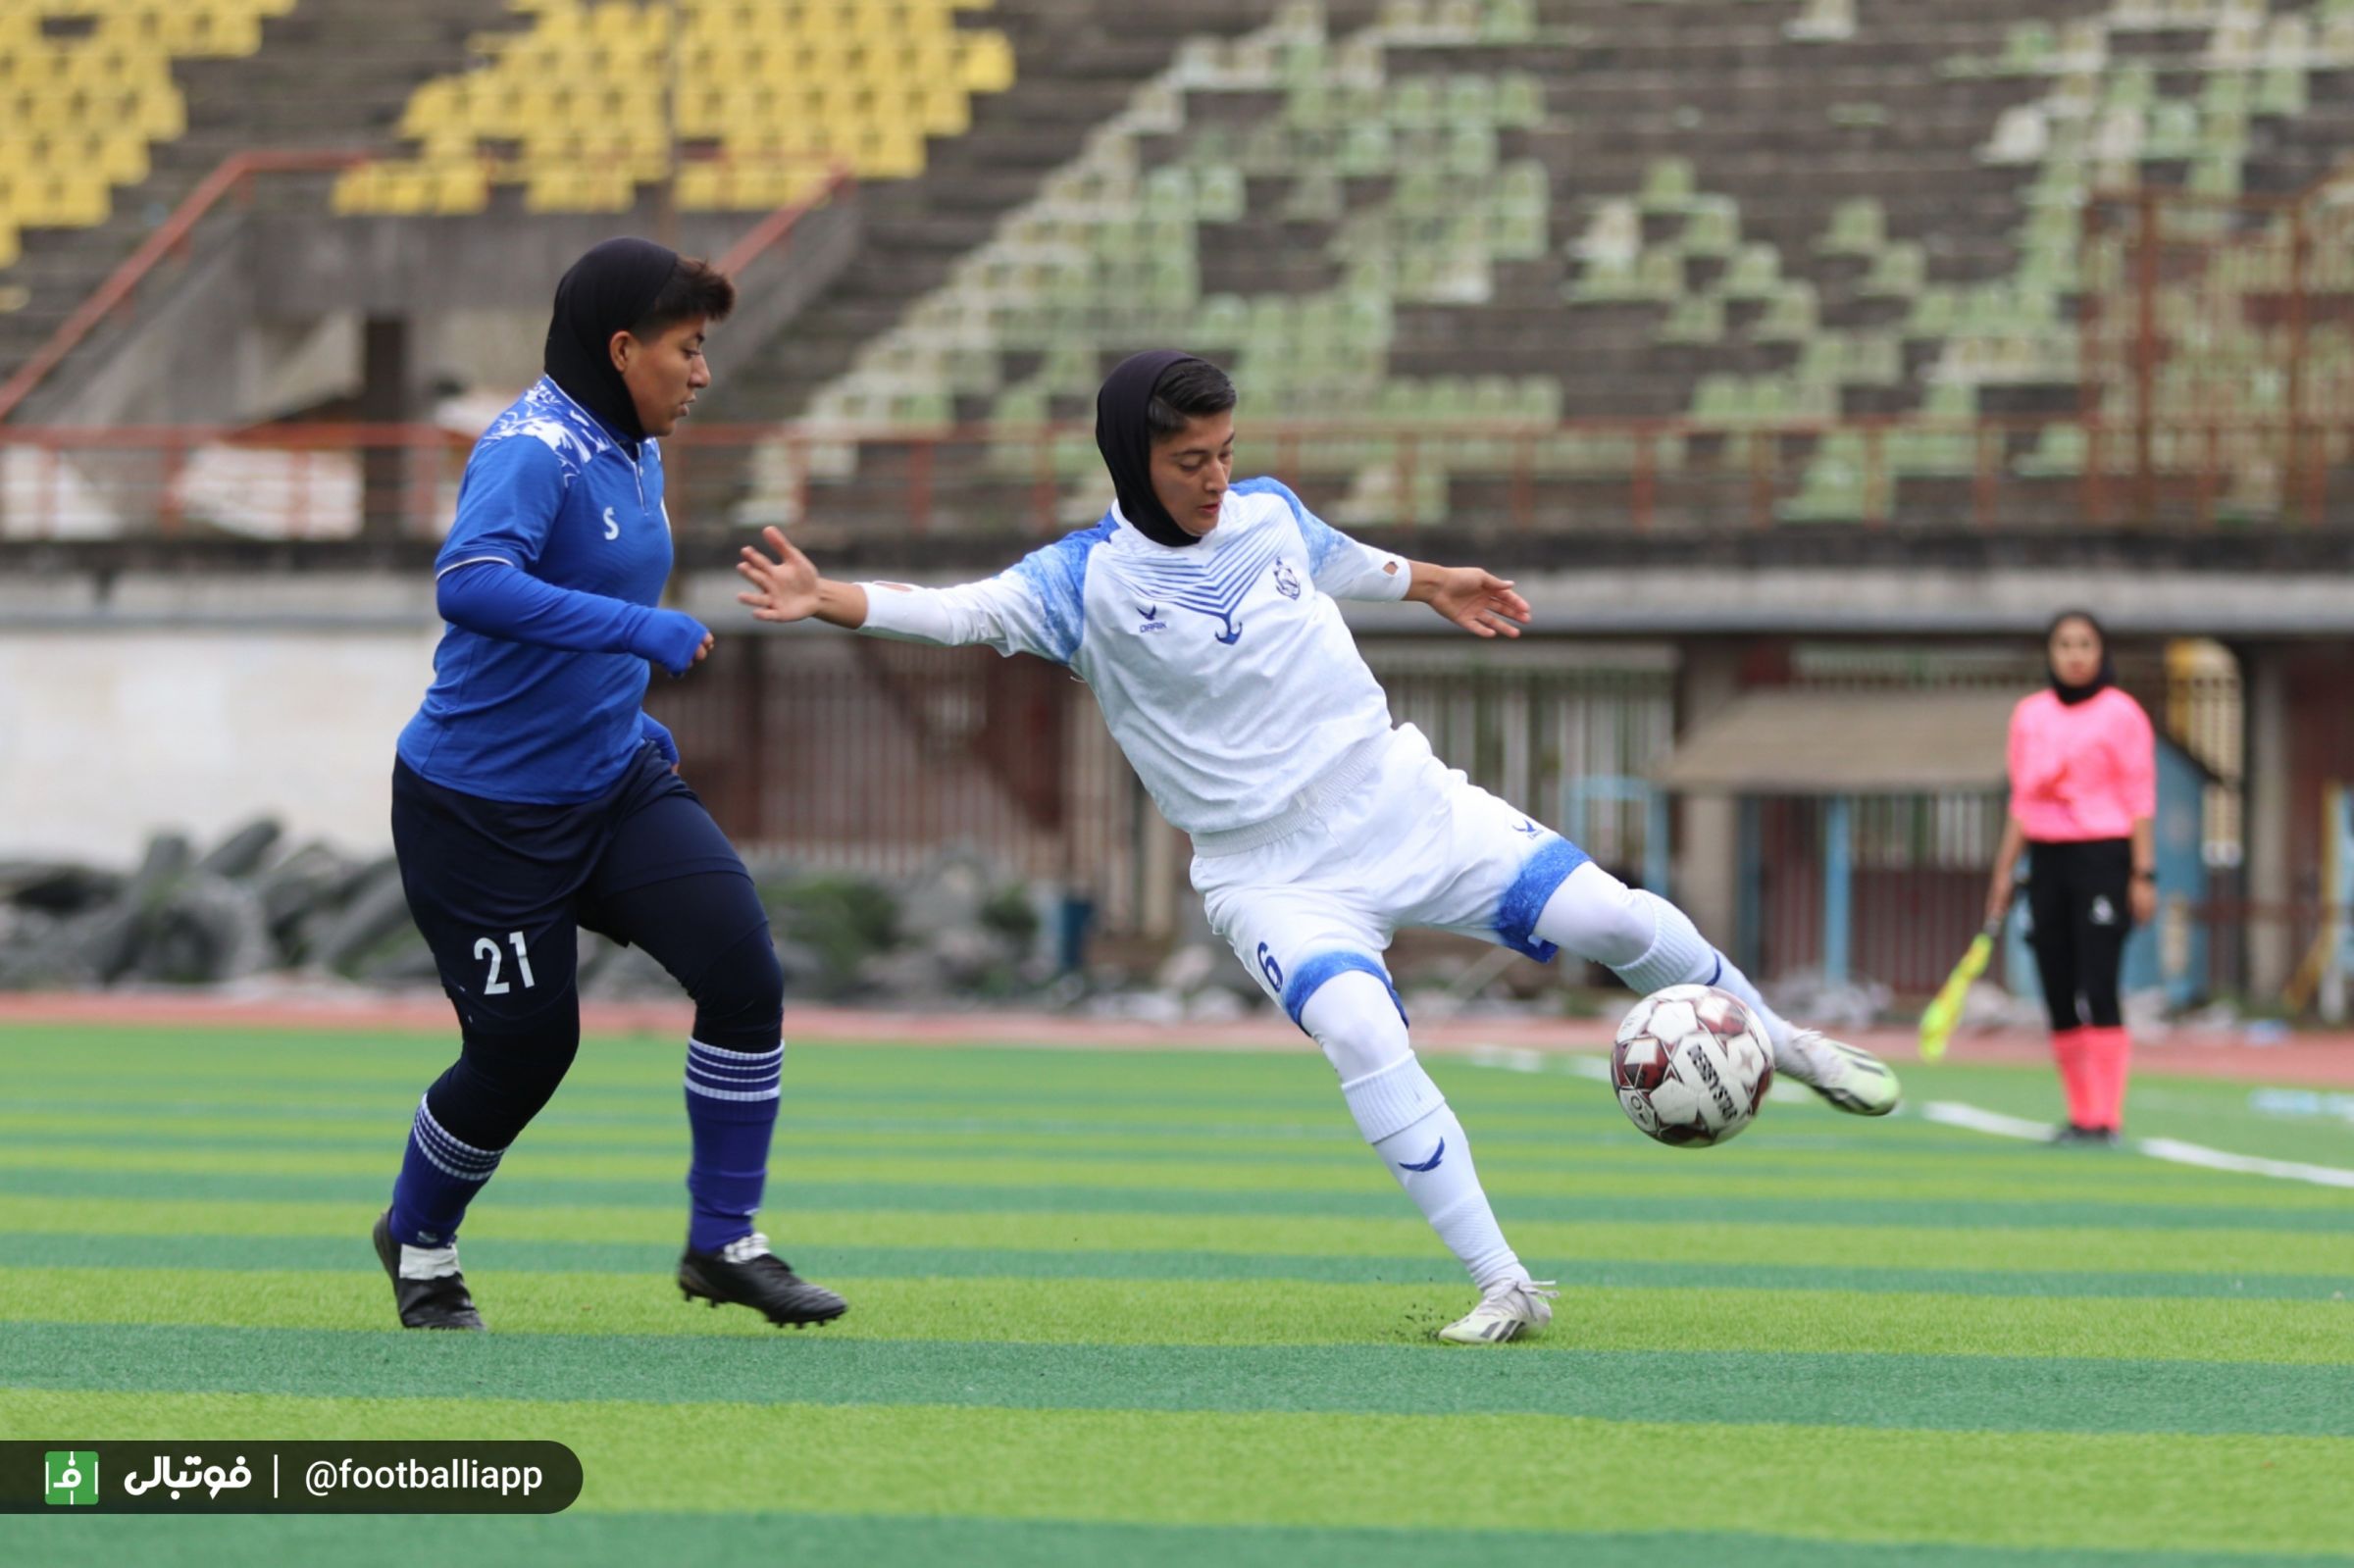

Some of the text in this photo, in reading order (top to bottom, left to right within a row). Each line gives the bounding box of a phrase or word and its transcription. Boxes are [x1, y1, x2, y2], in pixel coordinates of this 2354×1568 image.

[602, 506, 620, 540] S
[474, 931, 535, 995] 21
[1257, 941, 1283, 993] 6
